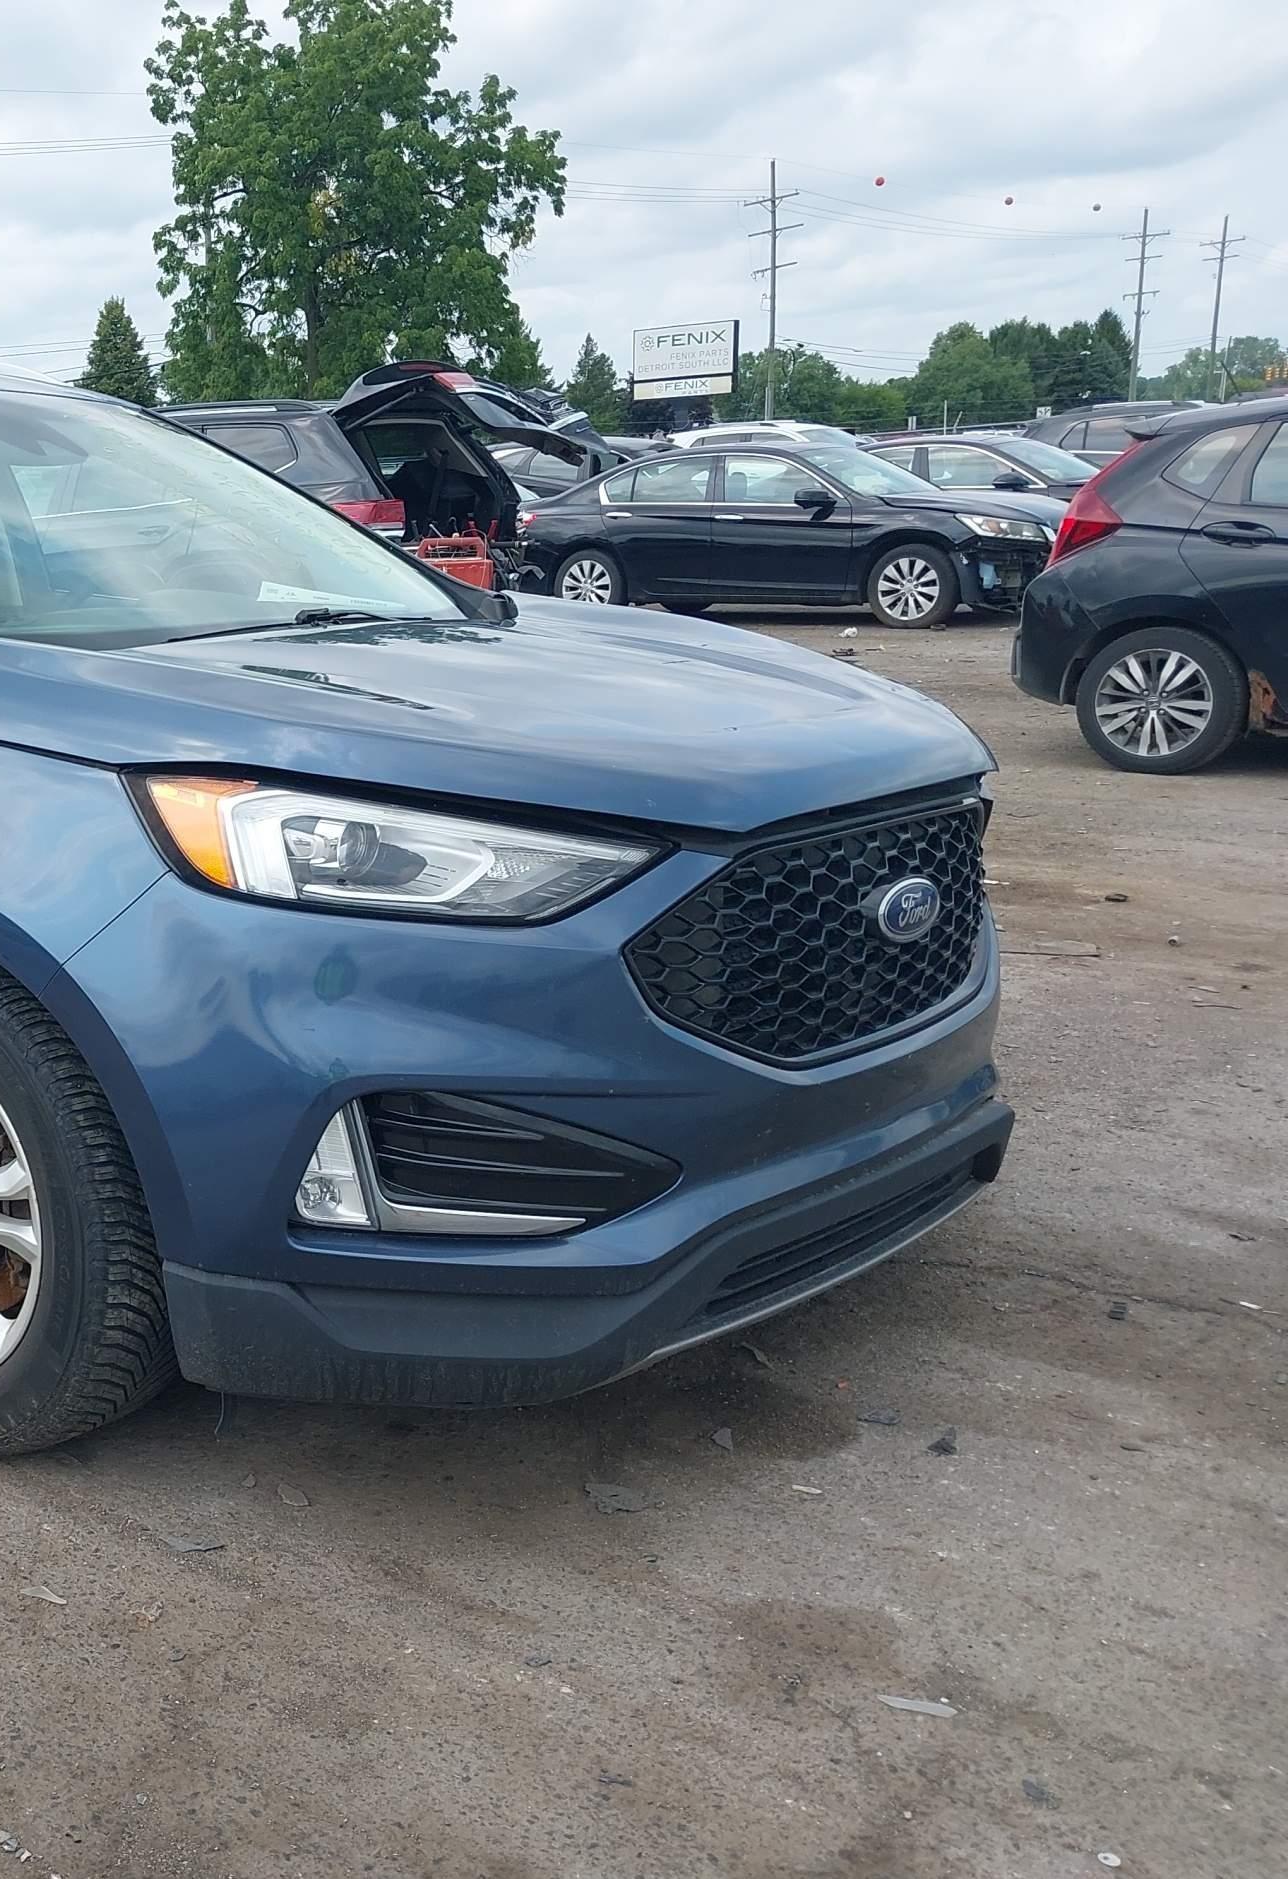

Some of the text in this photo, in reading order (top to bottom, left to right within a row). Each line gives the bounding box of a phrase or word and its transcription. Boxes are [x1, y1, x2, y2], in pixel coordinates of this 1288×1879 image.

[657, 329, 726, 348] FENIX
[670, 348, 729, 361] FENIX PARTS
[638, 357, 729, 373] DETROIT SOUTH LLC
[664, 379, 709, 392] FENIX
[898, 891, 931, 928] Ford
